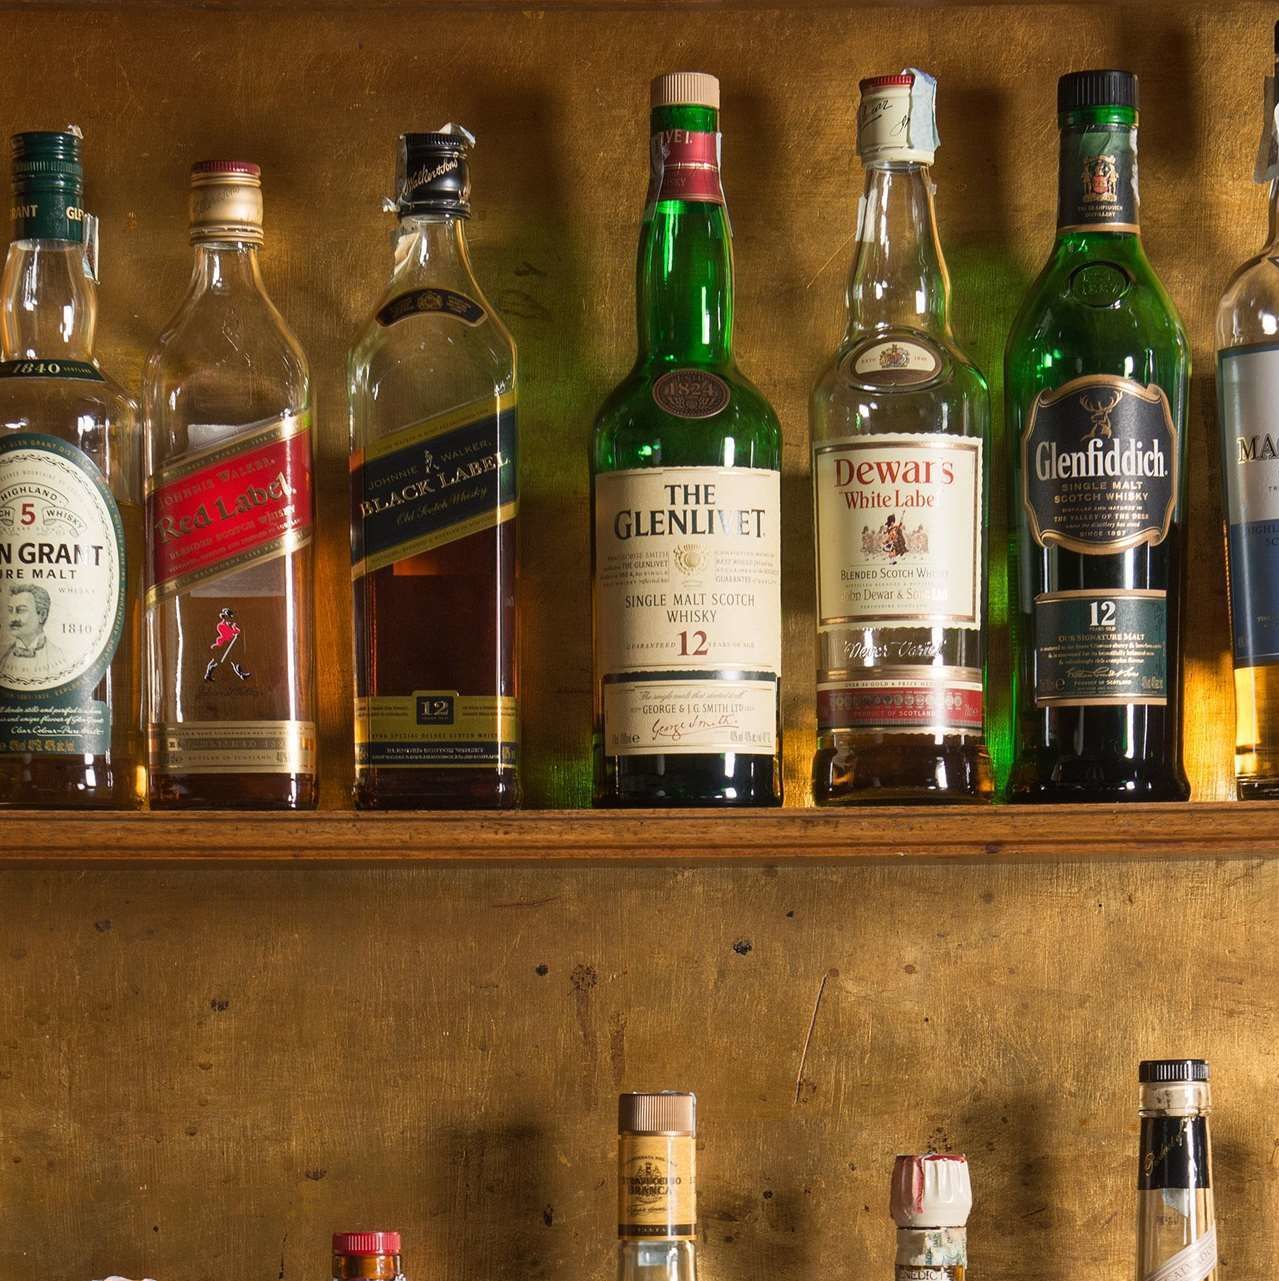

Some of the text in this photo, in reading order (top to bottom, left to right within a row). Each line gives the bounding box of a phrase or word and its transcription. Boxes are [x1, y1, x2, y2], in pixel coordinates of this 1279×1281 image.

[12, 363, 60, 374] 1840
[667, 382, 714, 396] 1824
[368, 464, 419, 491] JOHNNIE
[0, 486, 58, 502] HIGHLAND
[1062, 481, 1143, 491] SINGLE MALT
[360, 478, 436, 519] BLACK
[415, 500, 448, 519] Scotch
[451, 486, 488, 506] Whisky
[664, 484, 716, 505] THE
[895, 490, 936, 508] Labe
[1054, 492, 1149, 503] SCOTCH WHISKY
[20, 503, 36, 526] 5
[46, 509, 84, 530] WHISKY
[155, 503, 213, 545] Red
[614, 509, 766, 540] GLENLIVET
[18, 542, 104, 566] GRANT
[630, 560, 668, 568] GLENLIVET
[32, 569, 78, 580] MALT
[840, 567, 914, 581] BLENDED SCOTCH
[625, 593, 756, 609] SINGLE MALT SCOTCH
[863, 588, 895, 601] Dewar
[666, 610, 717, 623] WHISKY
[1090, 601, 1117, 627] 12
[61, 623, 92, 634] 1840
[676, 630, 709, 657] 12
[1124, 633, 1145, 641] MALT
[421, 700, 449, 716] 12
[642, 703, 729, 714] GEORGE SMITH
